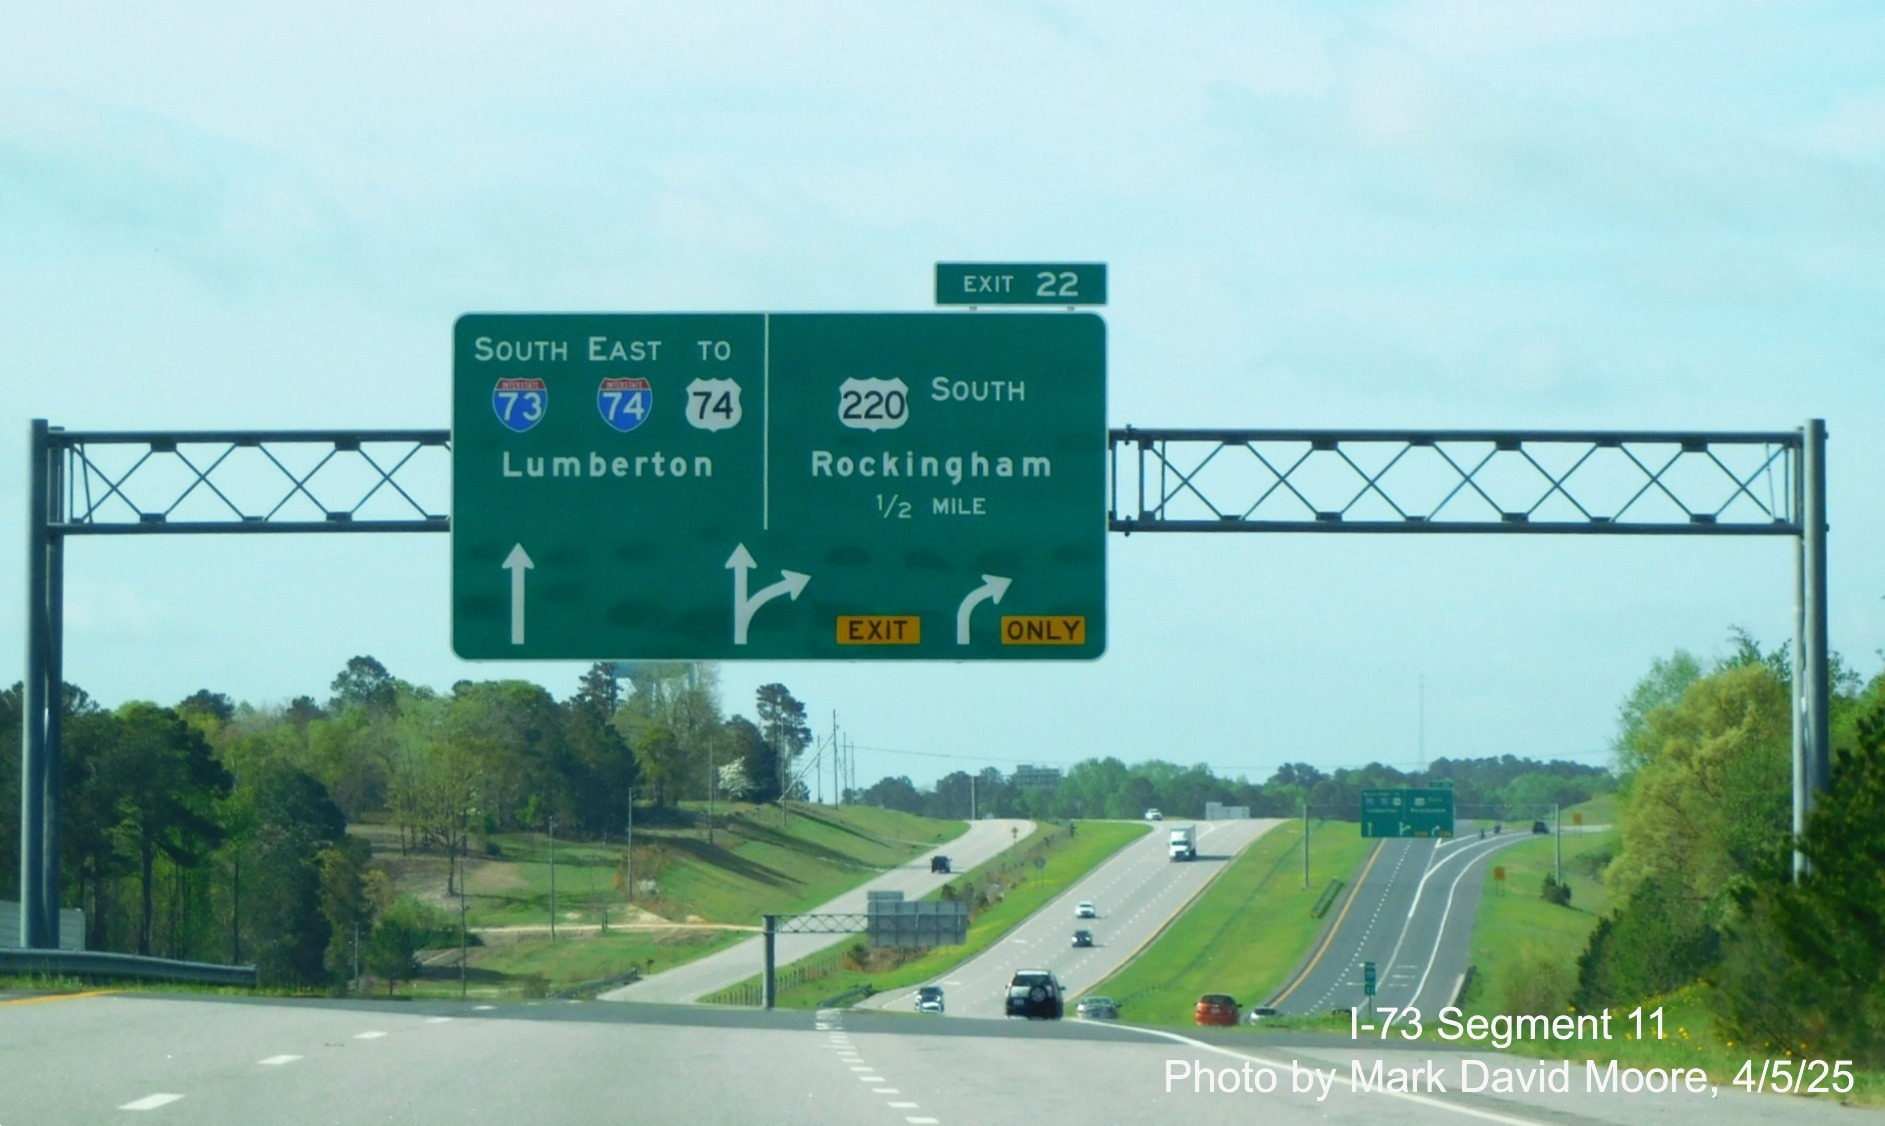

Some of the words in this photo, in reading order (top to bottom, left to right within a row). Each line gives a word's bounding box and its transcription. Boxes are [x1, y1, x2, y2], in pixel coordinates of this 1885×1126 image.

[963, 275, 1014, 293] EXIT
[1036, 271, 1079, 297] 22
[474, 336, 568, 362] SOUTH
[588, 336, 662, 361] EAST
[697, 340, 731, 361] TO
[502, 381, 540, 389] INTERSTATE
[606, 381, 643, 389] INTERSTATE
[842, 390, 907, 420] 220
[931, 376, 1026, 402] SOUTH
[498, 391, 543, 421] 73
[602, 391, 645, 421] 74
[692, 390, 734, 420] 74
[503, 451, 713, 477] Lumberton
[811, 450, 1052, 486] Rockingham
[932, 497, 986, 515] MILE
[848, 620, 908, 641] EXIT
[1006, 620, 1080, 641] ONLY
